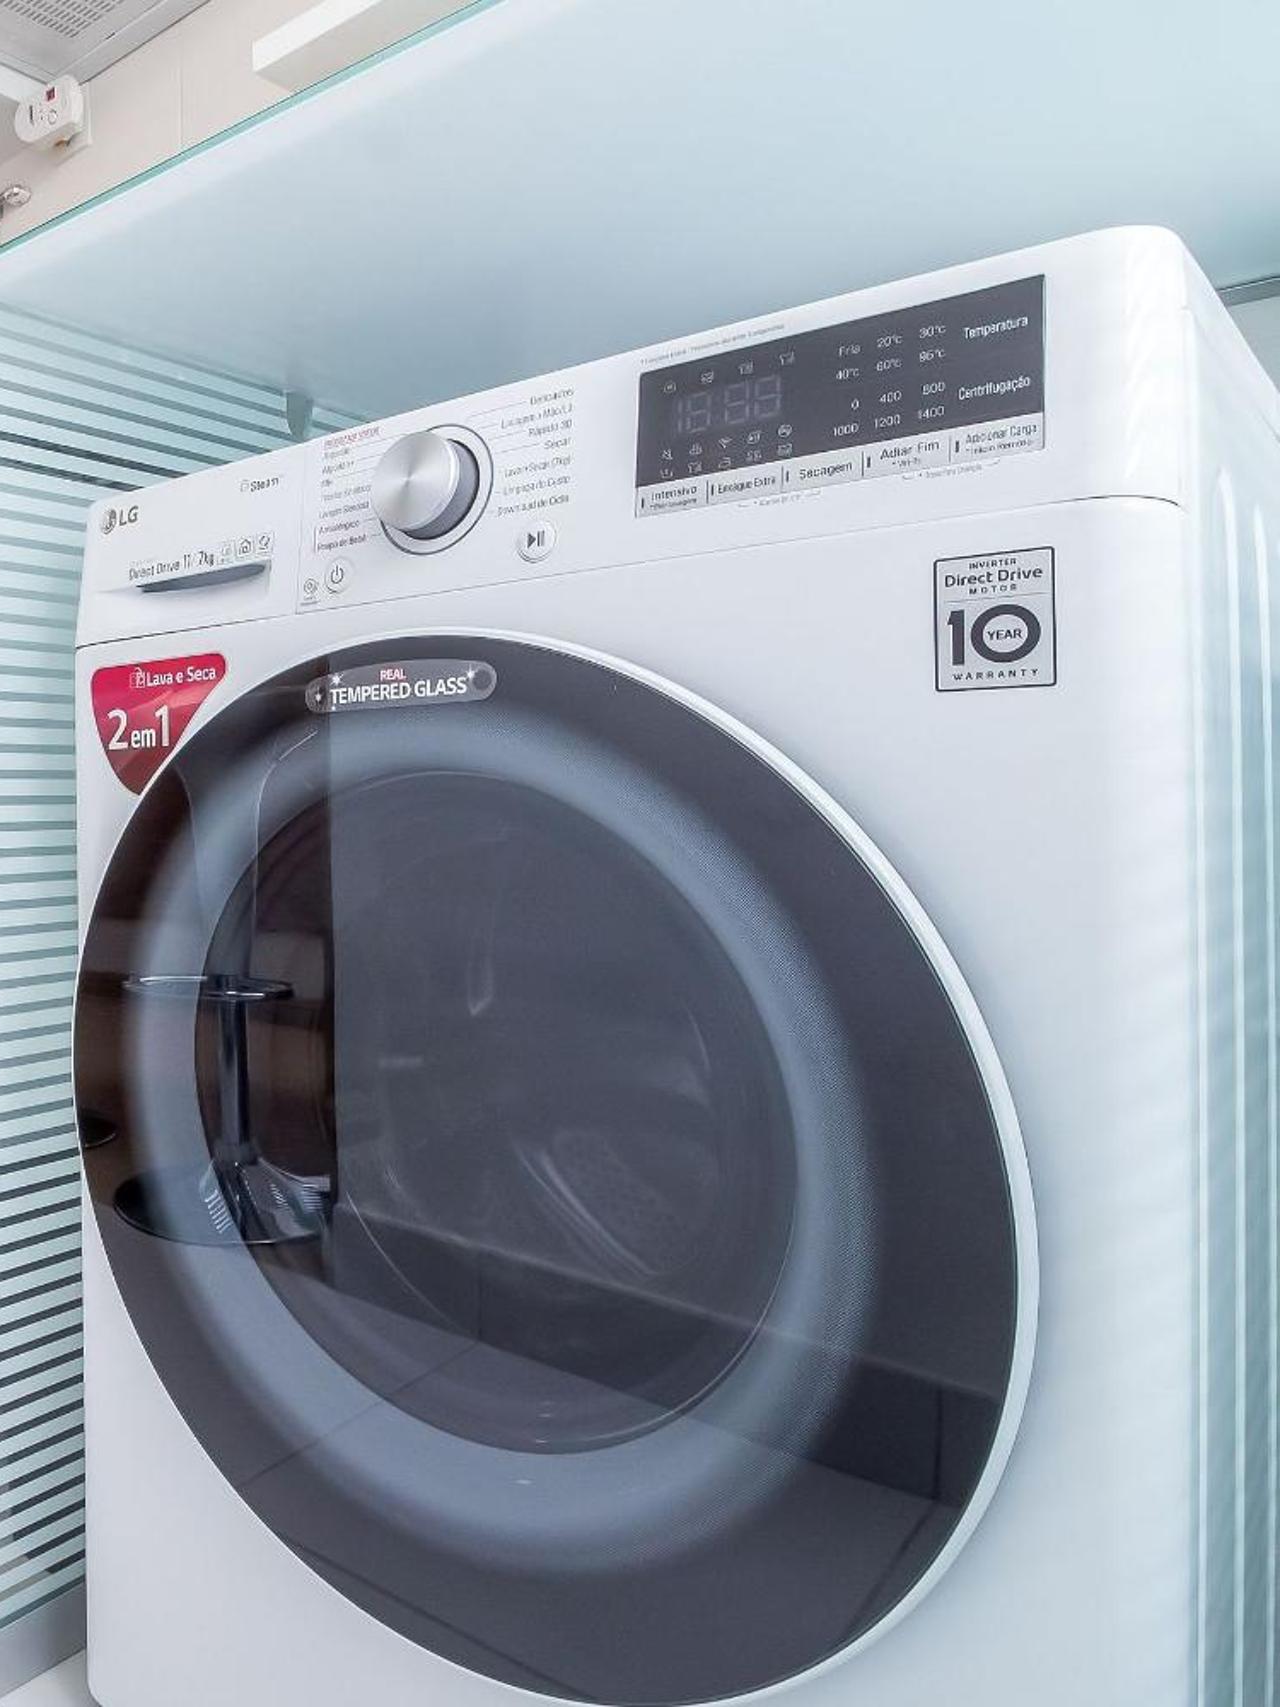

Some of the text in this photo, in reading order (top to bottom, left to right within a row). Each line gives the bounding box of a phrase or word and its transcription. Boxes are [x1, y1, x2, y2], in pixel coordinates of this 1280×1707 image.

[964, 316, 1029, 340] Temperatura
[879, 390, 902, 404] 400
[958, 374, 1031, 401] Centrifugação
[833, 405, 945, 437] 1000 1200 1400
[799, 461, 853, 480] Secagem
[118, 504, 139, 527] LG
[156, 560, 180, 575] Drive
[968, 557, 1018, 570] INVERTER
[944, 567, 1044, 588] Direct Drive
[968, 583, 1018, 595] MOTOR
[947, 603, 1042, 667] 10
[986, 628, 1024, 641] YEAR
[146, 665, 216, 687] Lava e Seca
[379, 667, 407, 682] REAL
[951, 668, 1039, 682] WARRANTY
[329, 676, 468, 705] TEMPERED GLASS
[107, 703, 171, 751] 2 em 1
